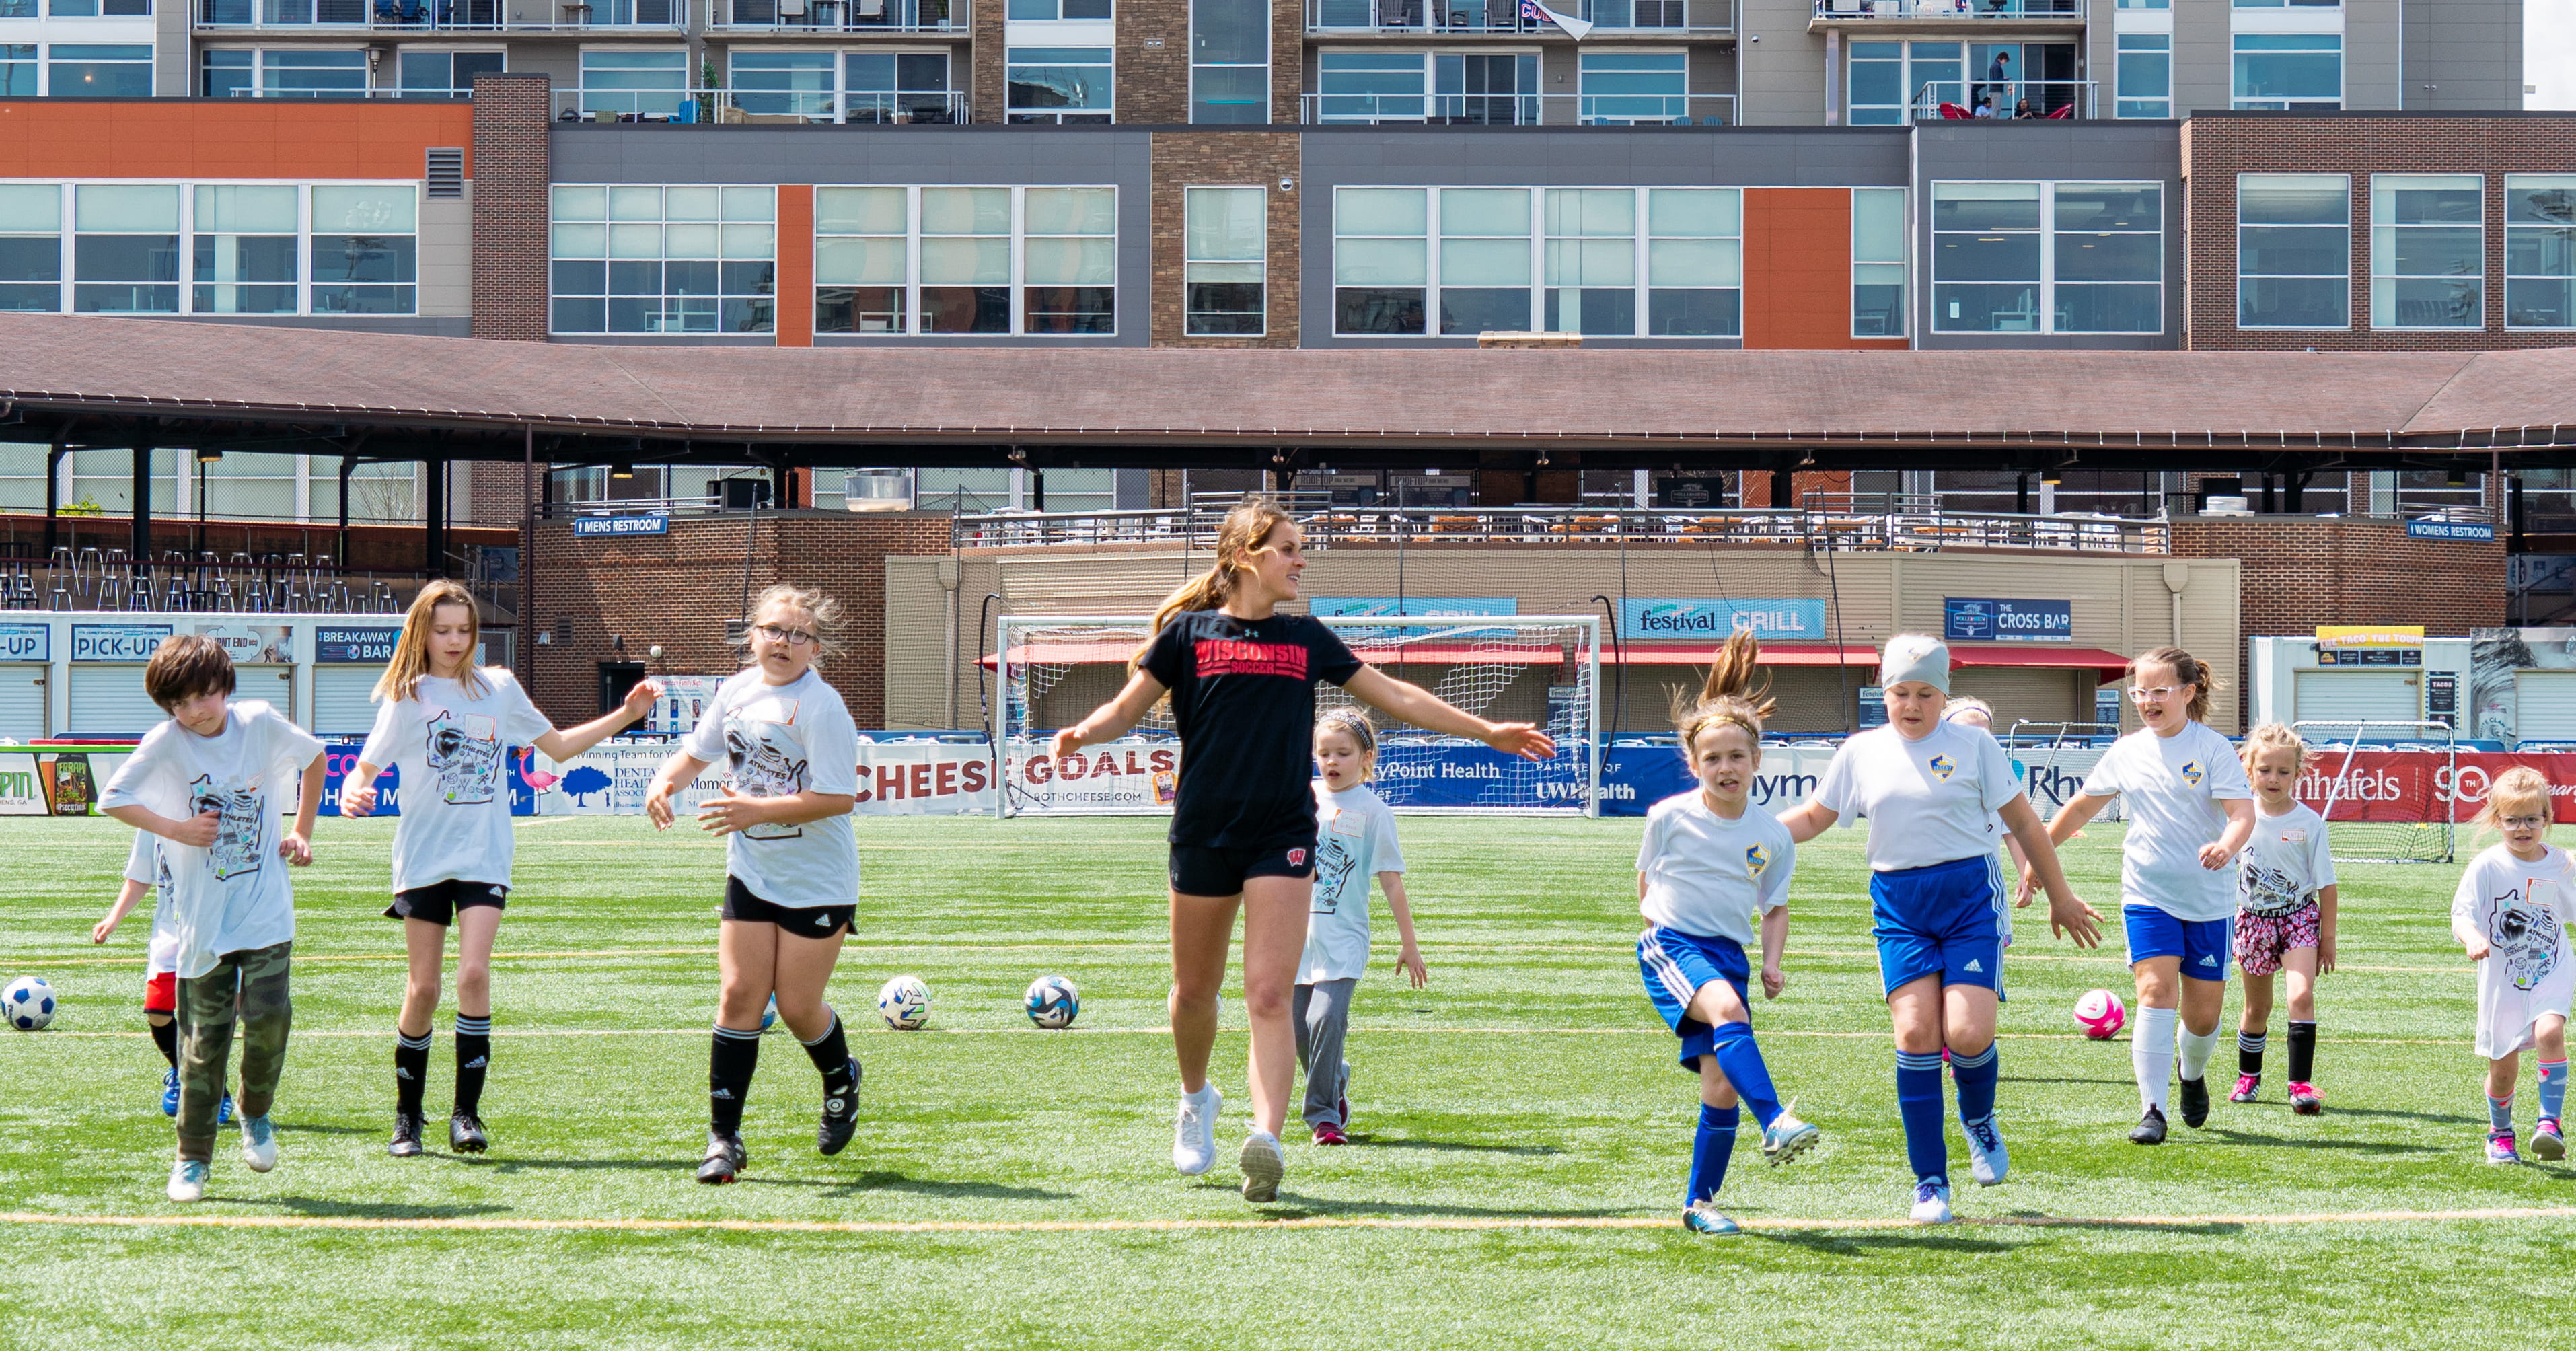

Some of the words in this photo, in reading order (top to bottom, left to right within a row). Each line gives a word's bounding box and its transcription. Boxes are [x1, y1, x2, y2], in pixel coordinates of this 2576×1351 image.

[1300, 475, 1333, 485] ROOFTOP
[1395, 476, 1428, 486] ROOFTOP
[584, 521, 612, 532] MENS
[613, 519, 661, 532] RESTROOM
[2415, 525, 2450, 536] WOMENS
[2451, 527, 2492, 538] RESTROOM
[1999, 604, 2012, 612] THE
[1640, 610, 1716, 631] festival
[1730, 611, 1805, 632] GRILL
[1998, 614, 2040, 629] CROSS
[2044, 614, 2069, 630] BAR
[233, 637, 248, 647] END
[323, 632, 391, 643] BREAKAWAY
[77, 638, 160, 655] PICK-UP
[363, 645, 392, 659] BAR
[1193, 639, 1308, 667] WISCONSIN
[1230, 661, 1275, 673] SOCCER
[620, 750, 647, 759] Team
[649, 749, 663, 759] for
[748, 758, 787, 779] ATHLETES
[1025, 749, 1175, 785] GOALS
[1441, 762, 1501, 778] Health
[1536, 763, 1588, 772] PARTNE
[614, 778, 653, 789] HEALT
[2294, 768, 2400, 801] nhafels
